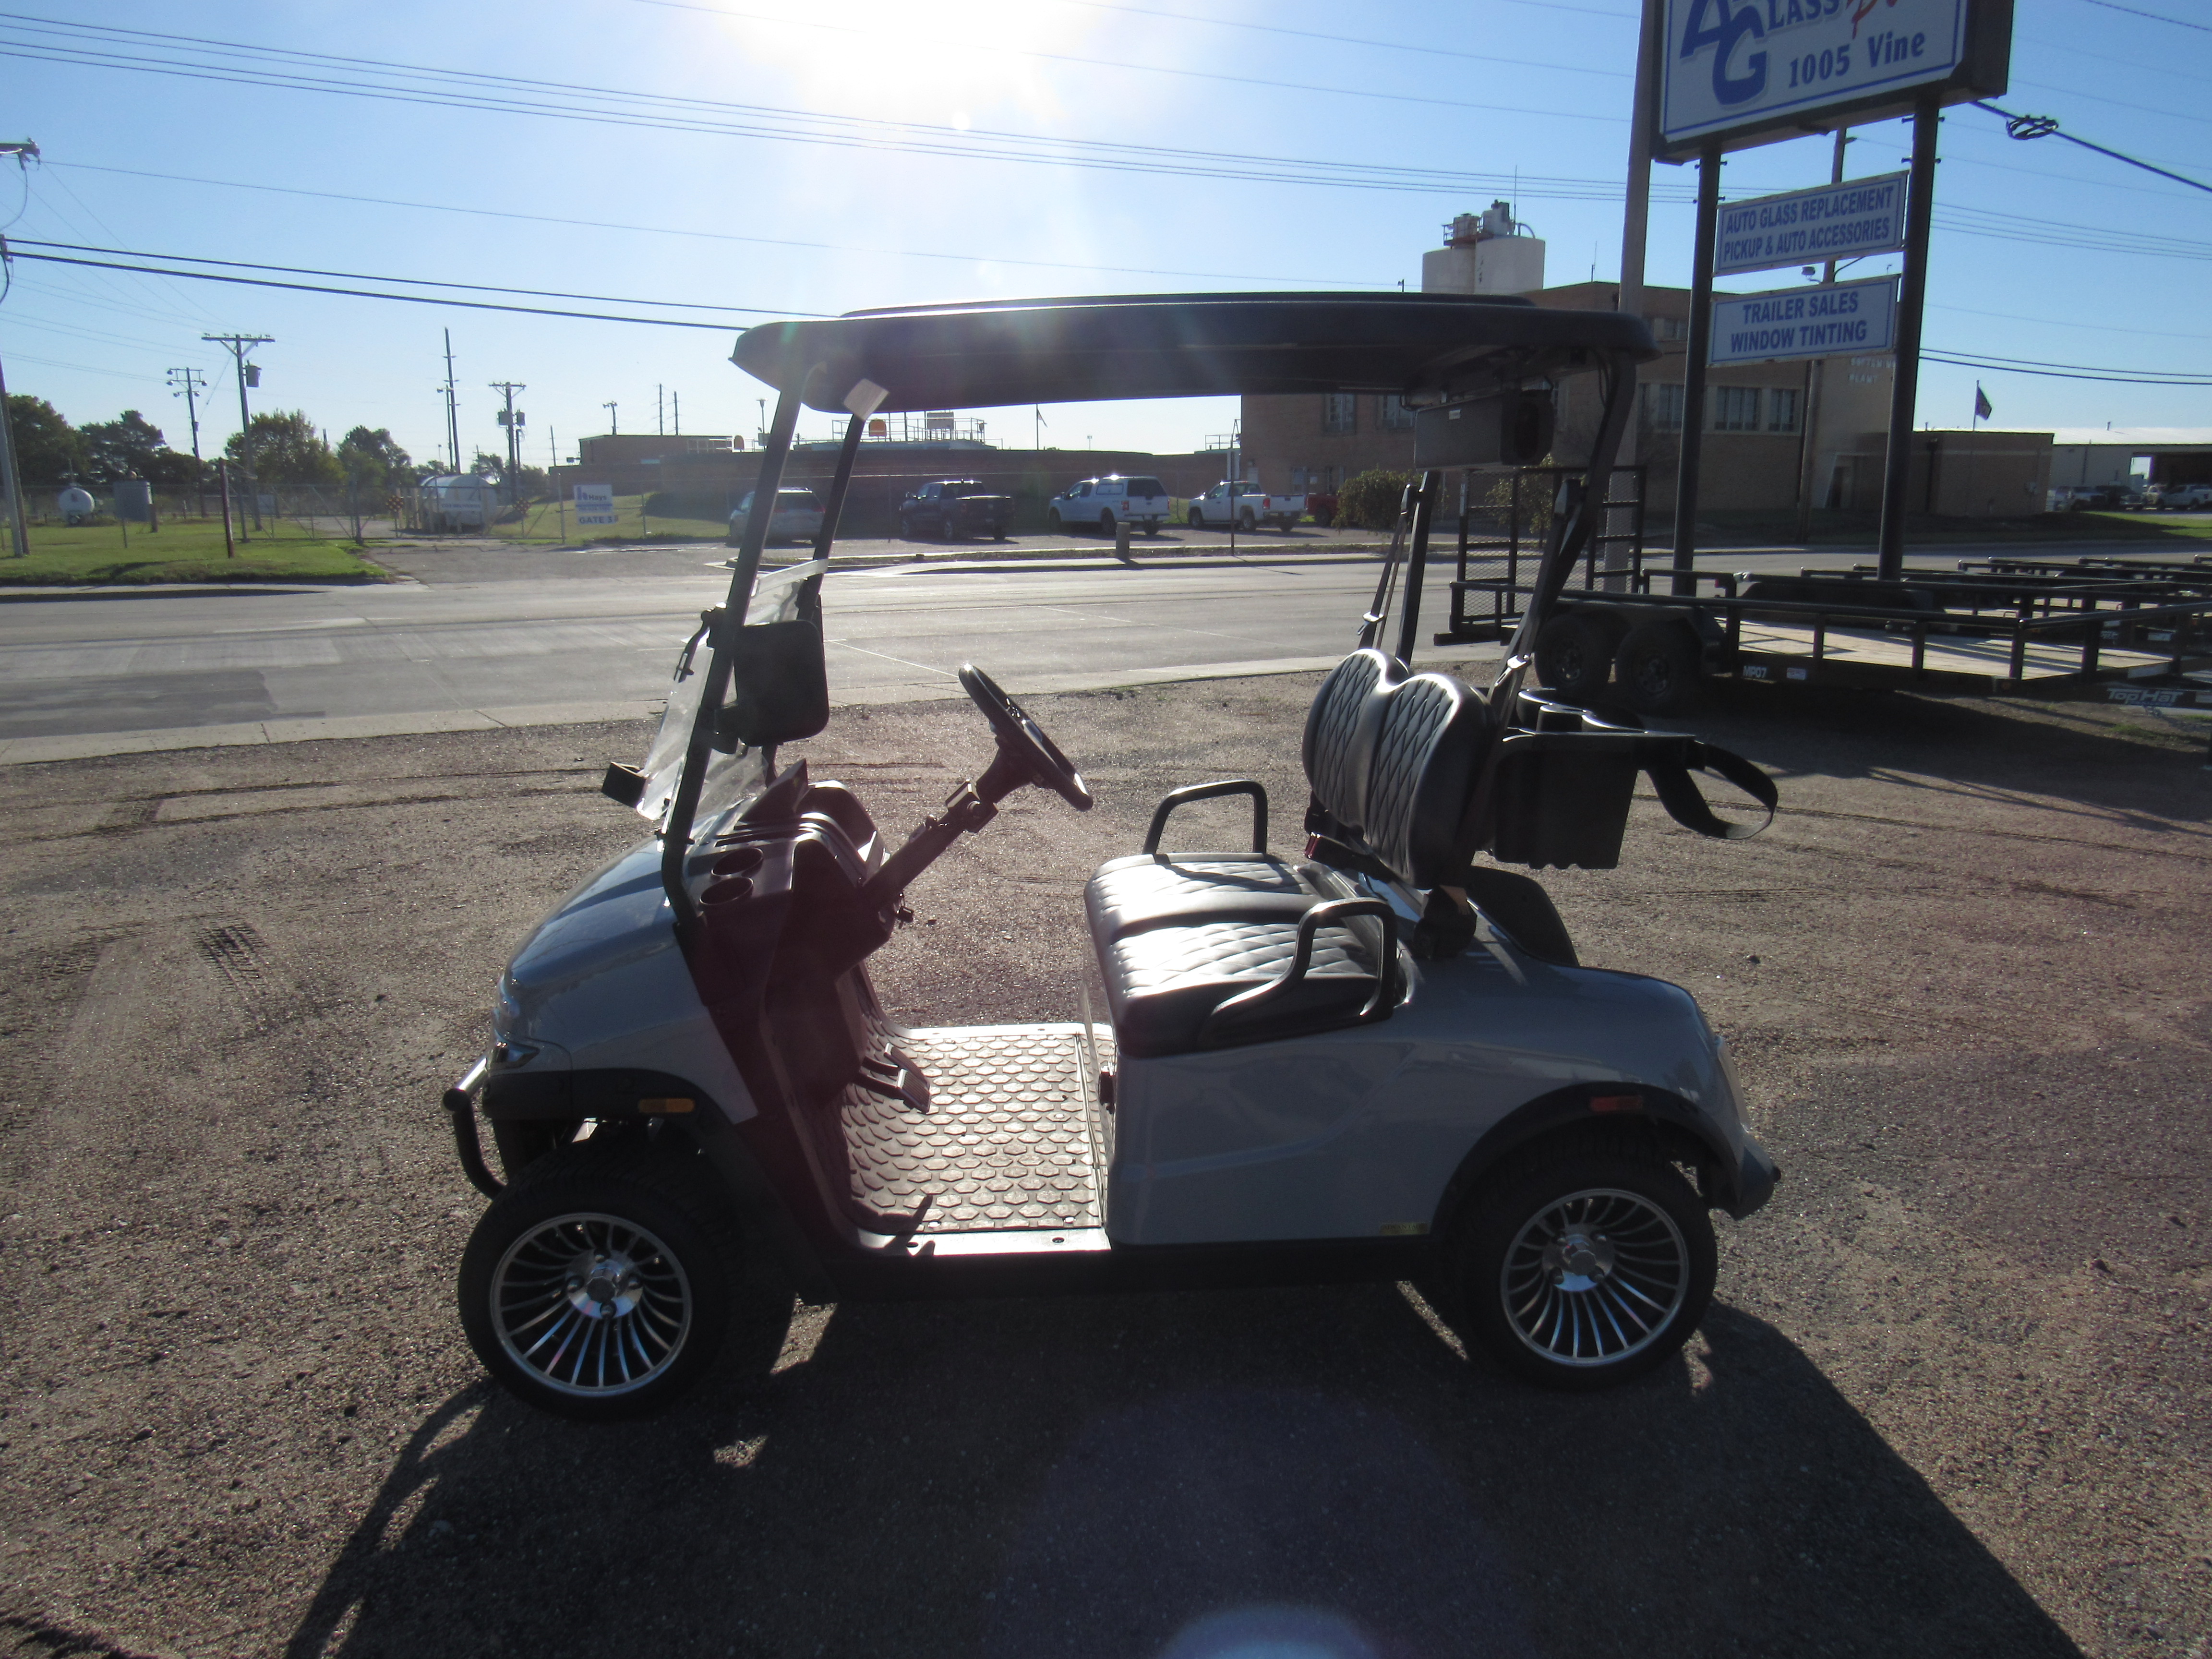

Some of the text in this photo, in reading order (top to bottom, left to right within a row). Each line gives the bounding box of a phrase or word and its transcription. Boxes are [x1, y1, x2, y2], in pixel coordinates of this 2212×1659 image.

[1788, 31, 1925, 88] 1005 Vine
[1726, 185, 1894, 234] AUTO GLASS REPLACEMENT
[1724, 217, 1890, 262] PICKUP & AUTO ACCESSORIES
[1743, 291, 1858, 325] TRAILER SALES
[1731, 320, 1867, 353] WINDOW TINTING
[579, 516, 605, 524] GATE
